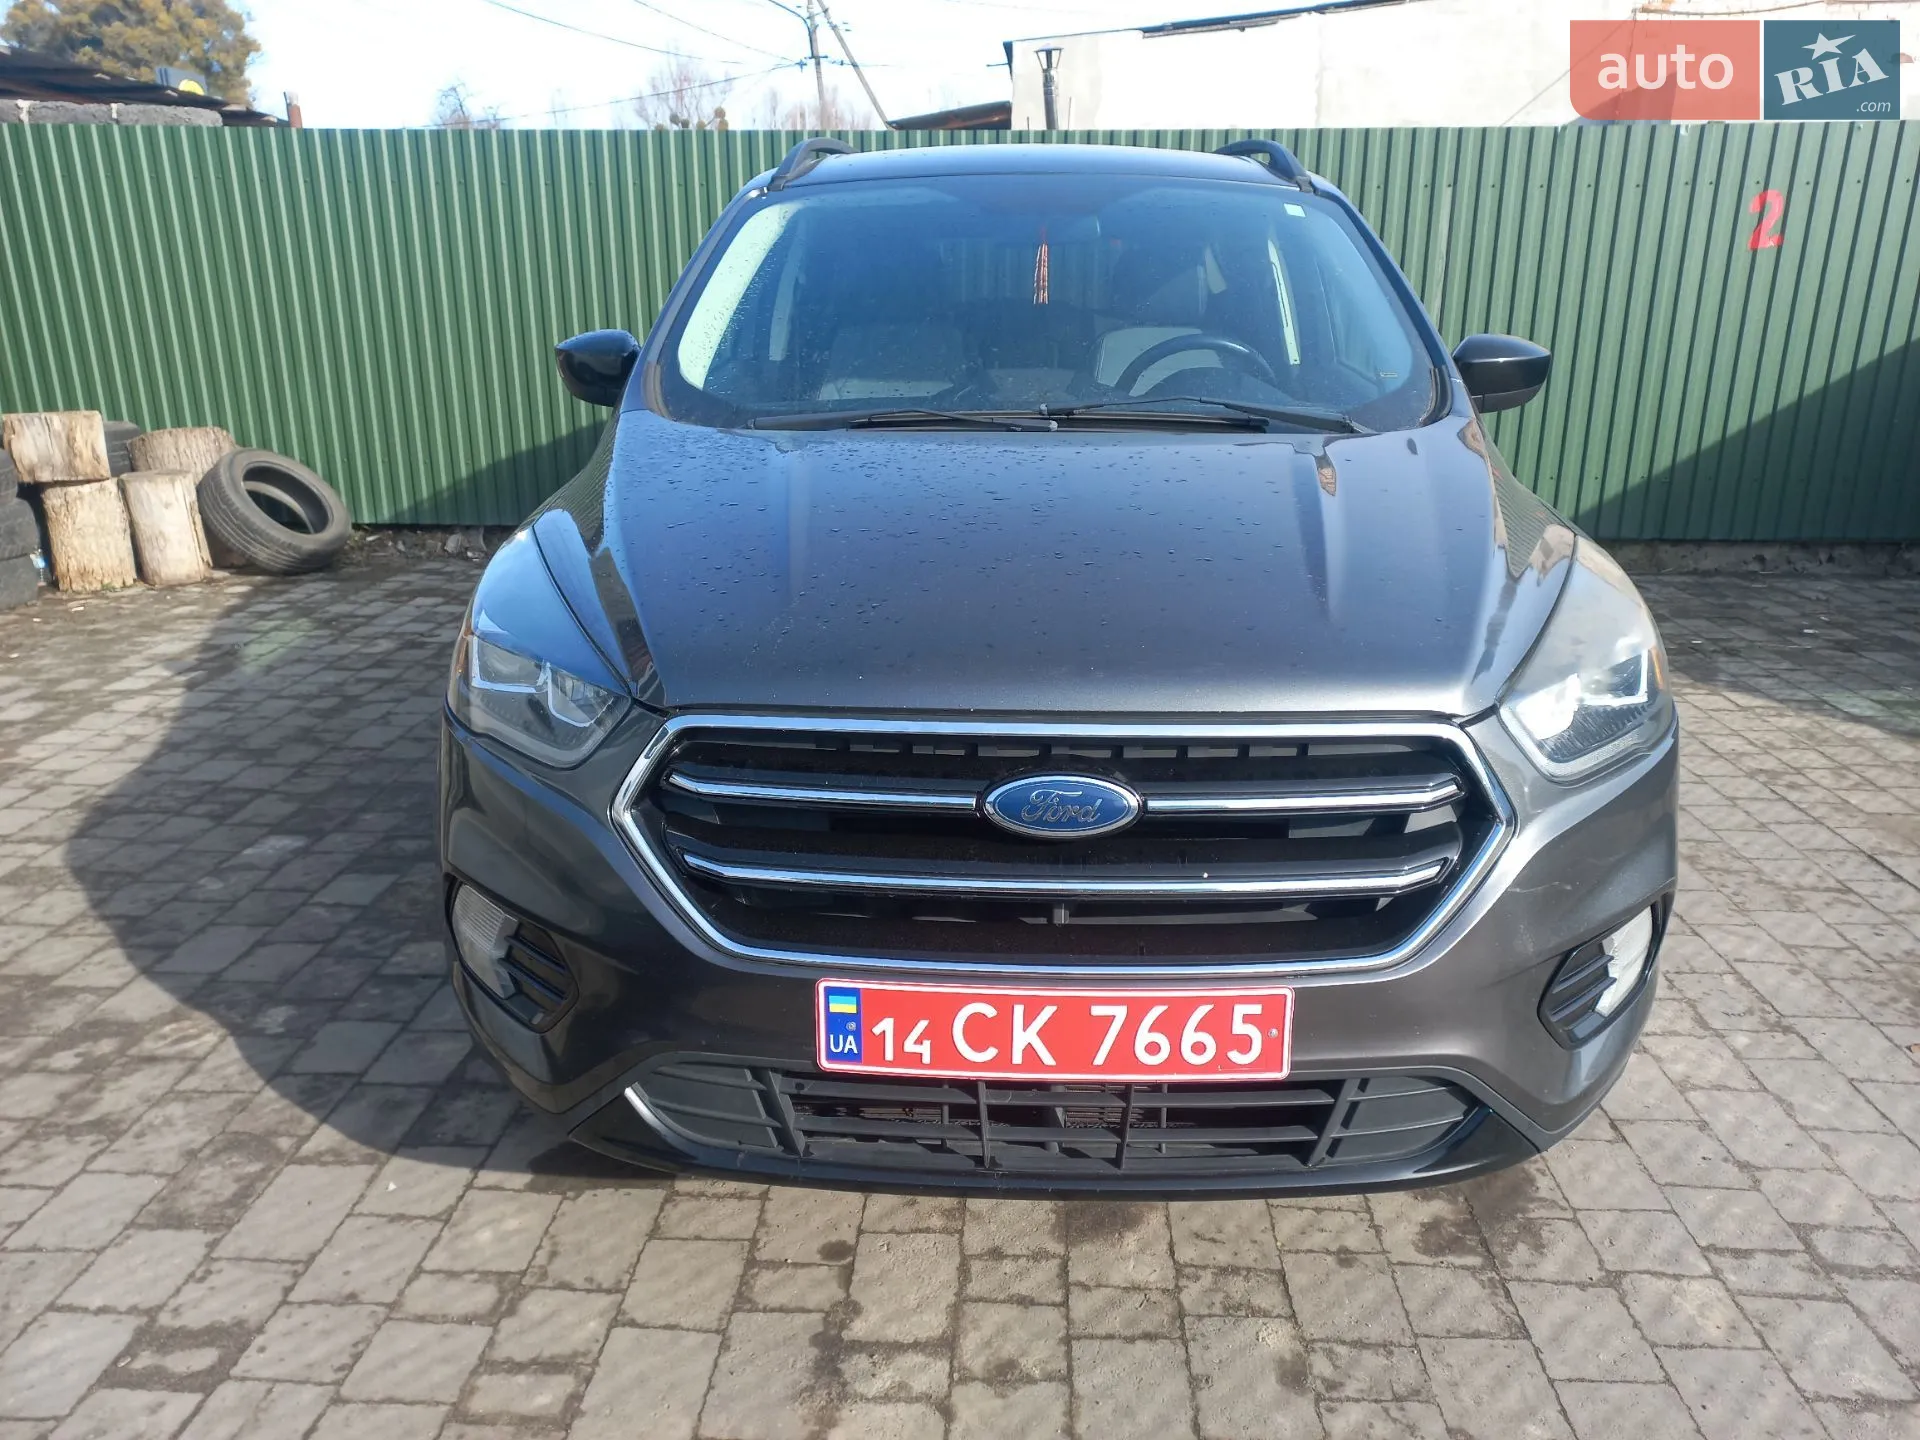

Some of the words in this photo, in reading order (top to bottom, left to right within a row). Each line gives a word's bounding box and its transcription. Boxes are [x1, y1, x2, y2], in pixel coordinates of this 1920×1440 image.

[1747, 189, 1784, 251] 2
[1021, 789, 1103, 823] Ford
[829, 1034, 858, 1054] UA
[871, 1017, 931, 1064] 14
[951, 1002, 1058, 1066] CK
[1090, 1003, 1263, 1066] 7665
